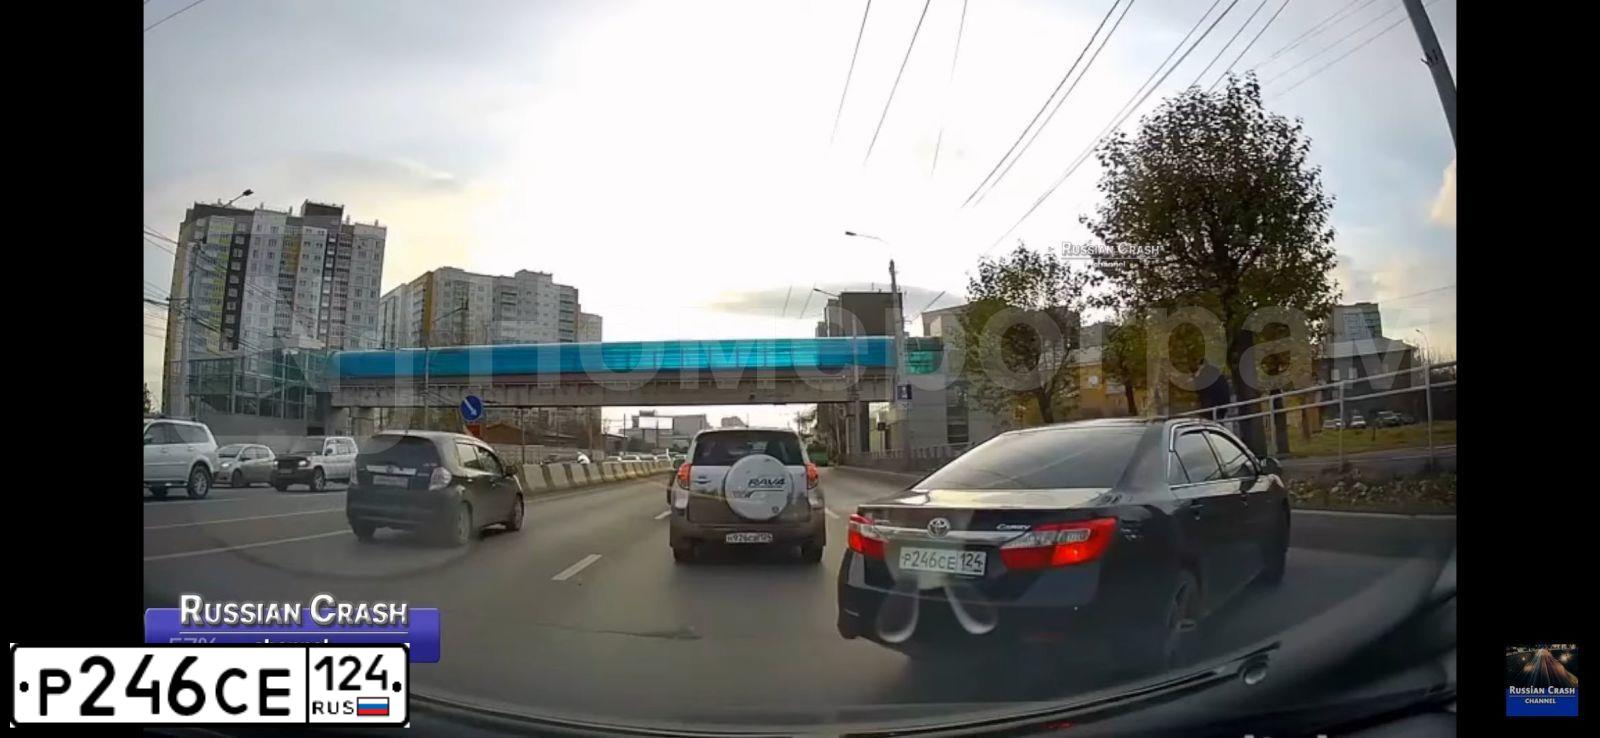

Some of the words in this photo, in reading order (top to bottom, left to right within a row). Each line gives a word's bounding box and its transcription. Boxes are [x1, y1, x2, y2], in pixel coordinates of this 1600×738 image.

[748, 478, 785, 487] RAV4
[903, 550, 956, 570] Р246СЕ
[960, 552, 984, 570] 124
